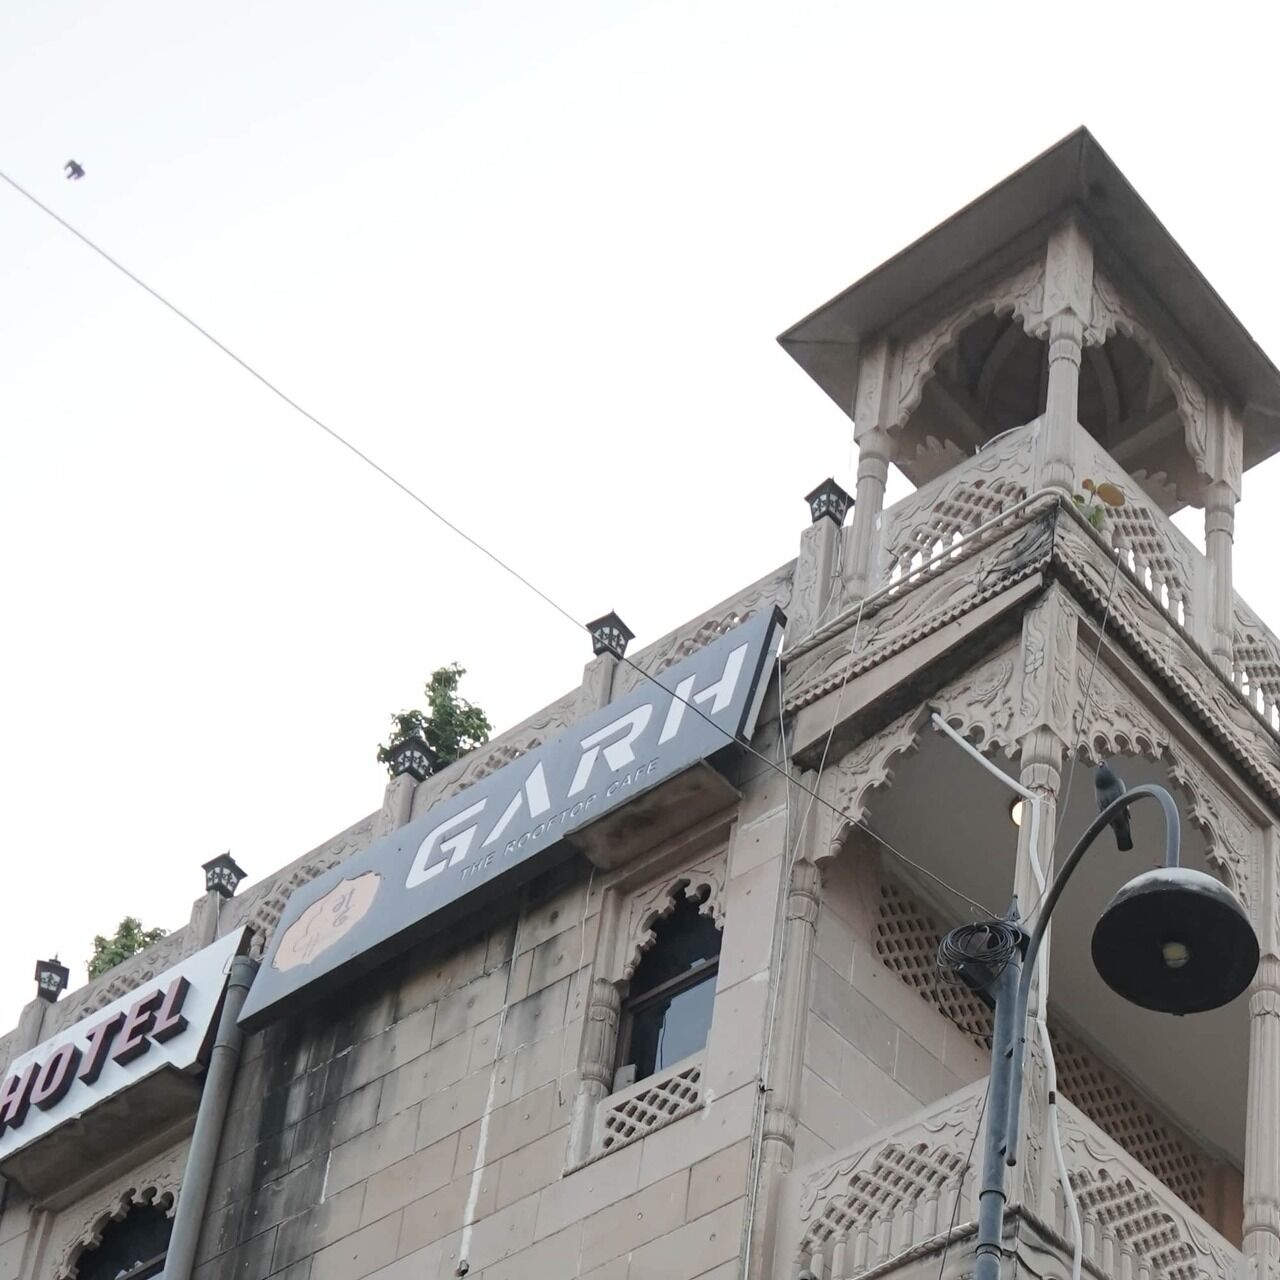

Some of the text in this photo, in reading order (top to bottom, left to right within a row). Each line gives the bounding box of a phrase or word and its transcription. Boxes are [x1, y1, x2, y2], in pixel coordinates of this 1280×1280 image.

[405, 642, 749, 889] GARH
[459, 756, 660, 881] THE ROOFTOP CAFE
[0, 976, 190, 1130] HOTEL
